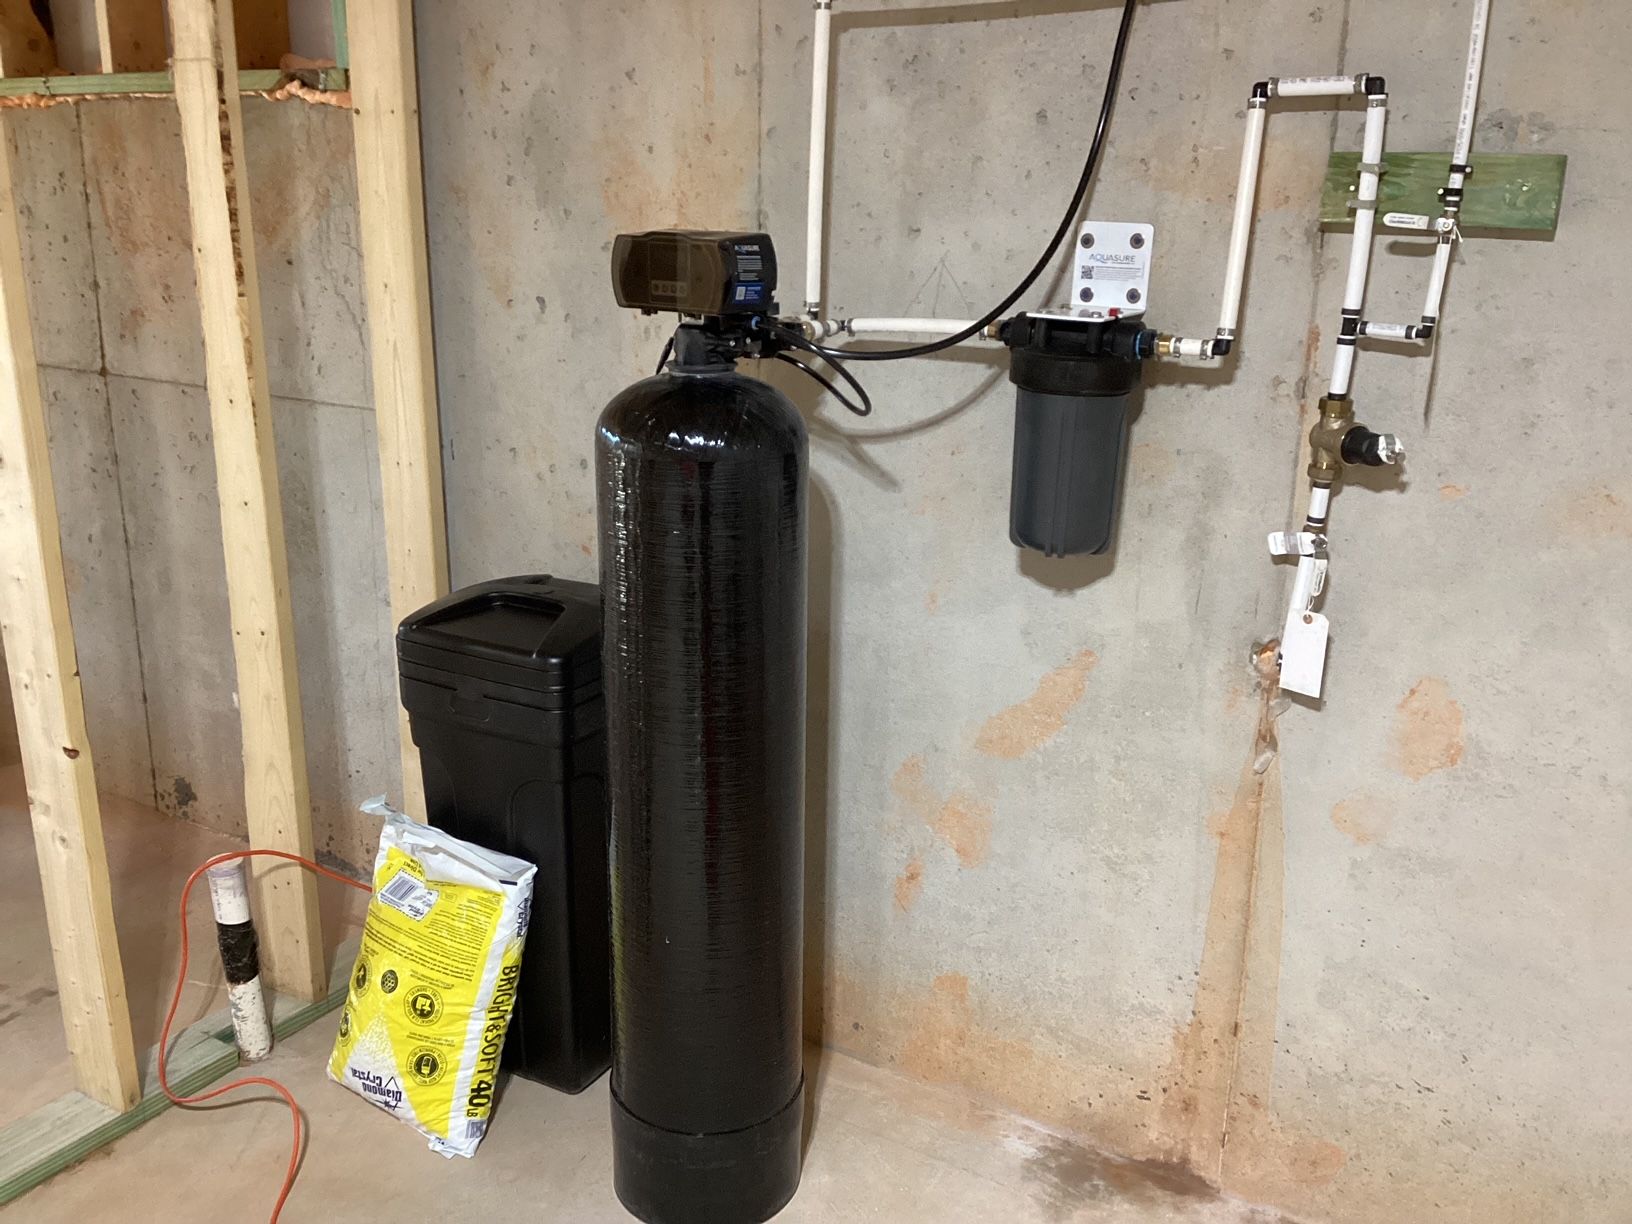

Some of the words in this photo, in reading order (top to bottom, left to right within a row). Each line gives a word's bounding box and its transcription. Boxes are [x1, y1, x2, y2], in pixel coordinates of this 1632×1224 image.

[1089, 253, 1136, 264] AQUASURE
[350, 1066, 382, 1087] Crystal
[362, 1081, 402, 1102] Diamond
[468, 1080, 492, 1107] 40
